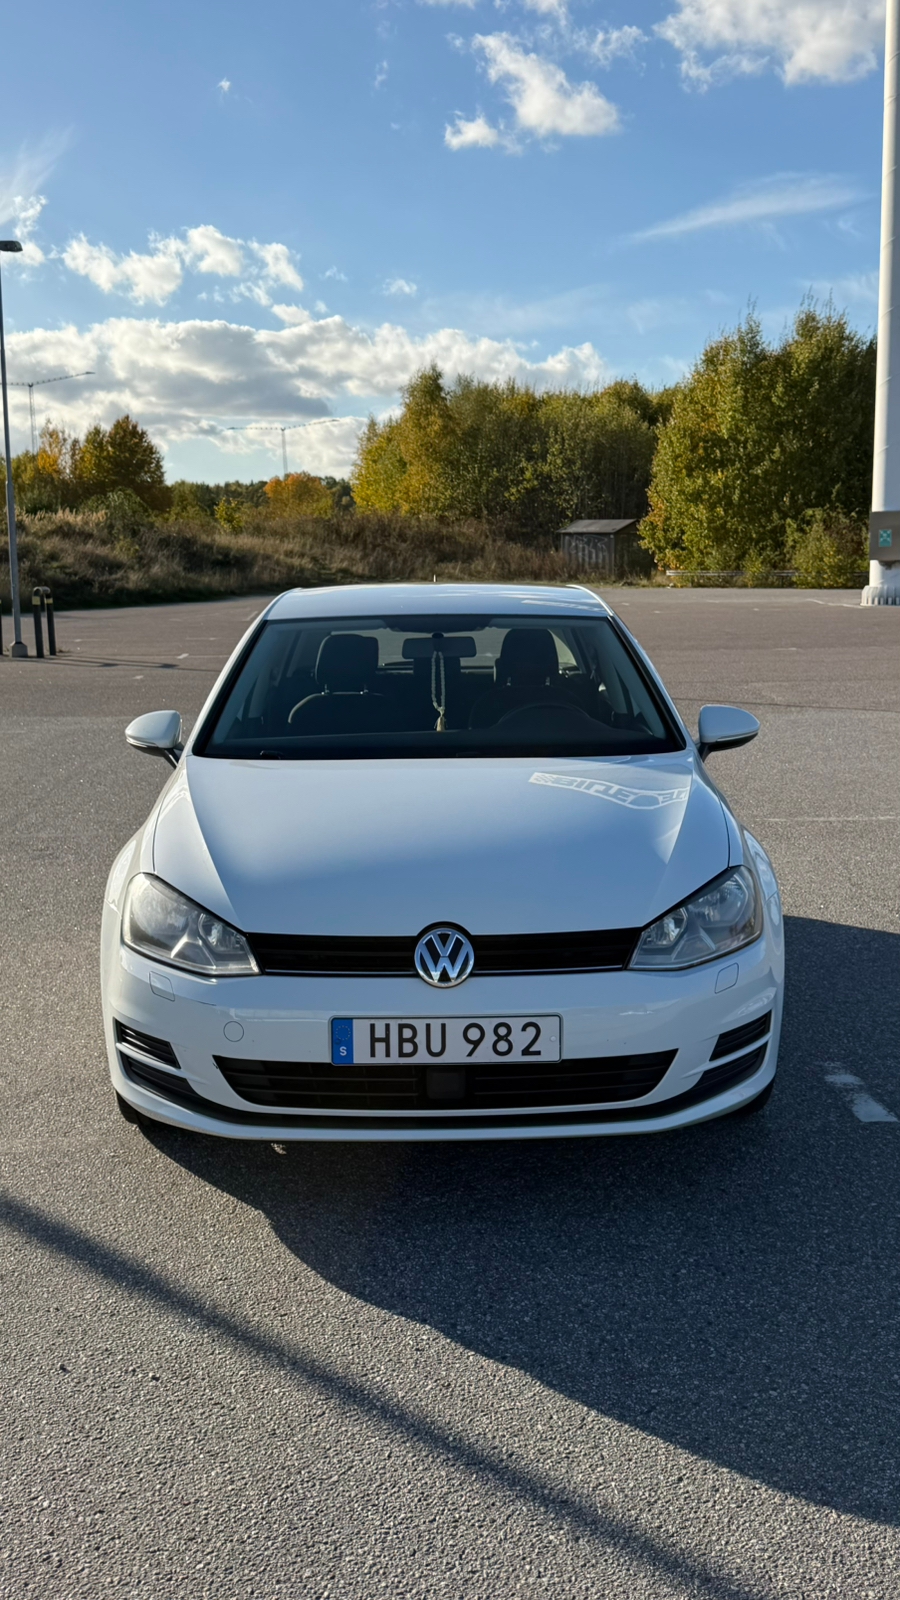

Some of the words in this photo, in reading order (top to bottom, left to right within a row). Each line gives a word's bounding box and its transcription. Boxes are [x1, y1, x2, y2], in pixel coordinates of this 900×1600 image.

[415, 929, 474, 988] VW
[339, 1046, 348, 1056] S
[369, 1022, 447, 1058] HBU
[462, 1021, 542, 1058] 982
